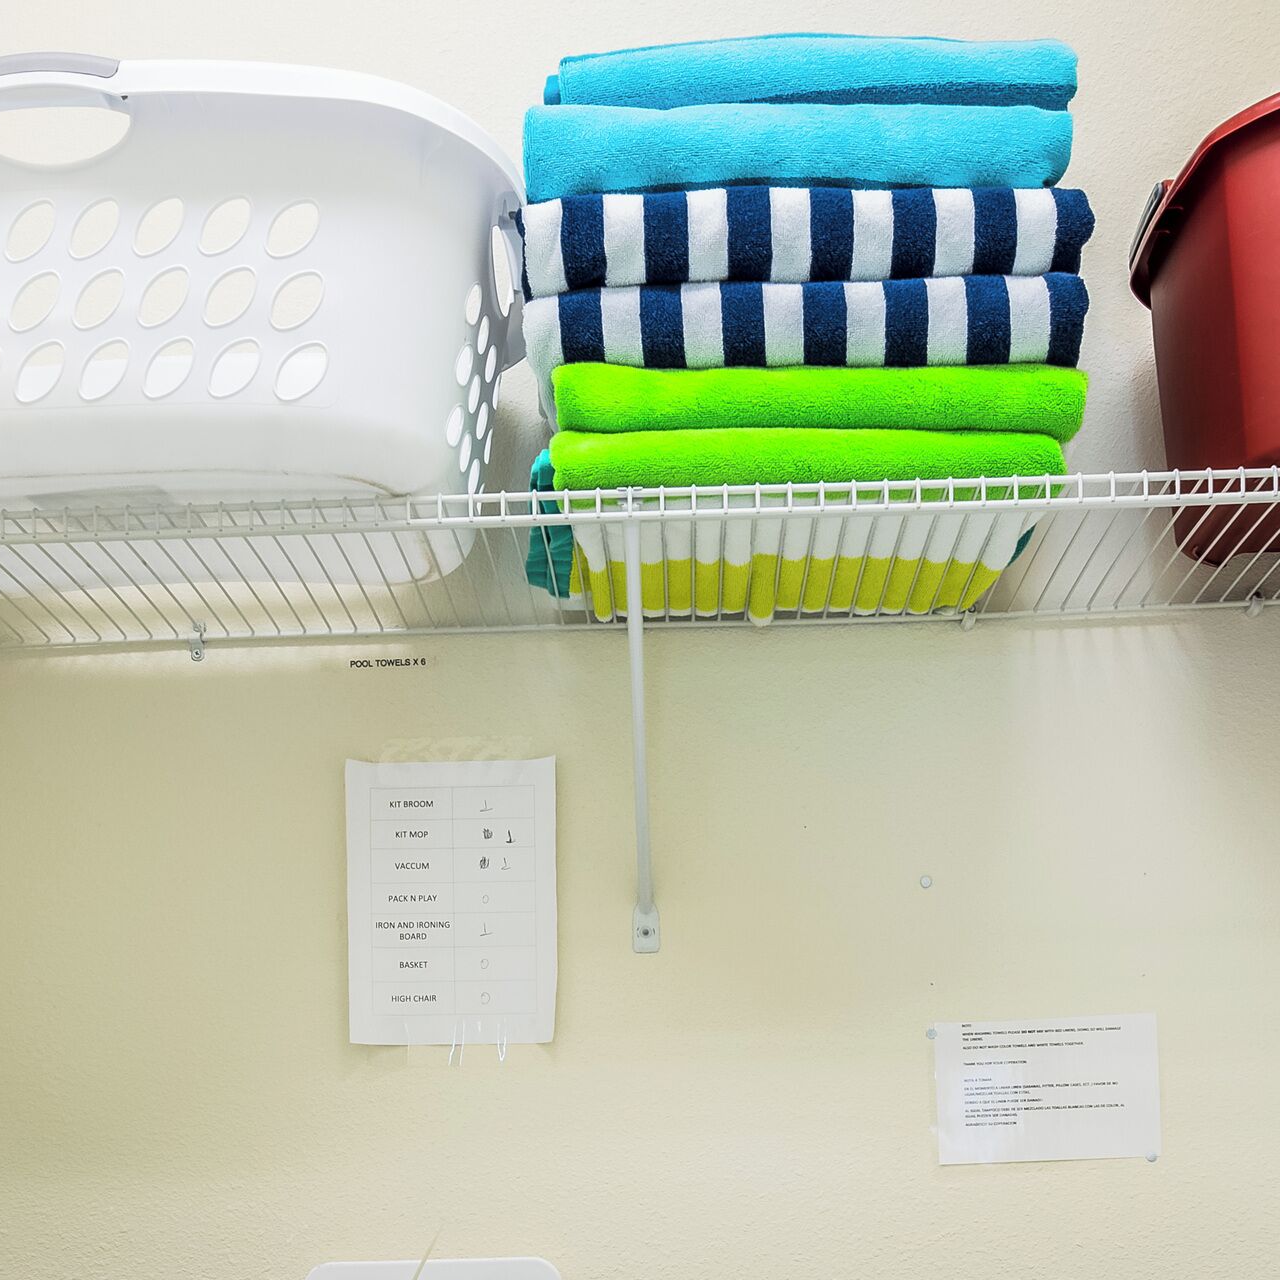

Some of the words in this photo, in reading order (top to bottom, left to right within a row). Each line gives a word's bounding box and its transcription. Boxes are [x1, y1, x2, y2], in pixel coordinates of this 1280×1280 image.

[350, 660, 373, 668] POOL
[376, 659, 410, 667] TOWELS
[390, 800, 402, 808] KIT
[404, 800, 434, 808] BROOM
[410, 830, 428, 838] MOP
[395, 862, 430, 870] VACCUM
[418, 894, 438, 902] PLAY
[397, 921, 414, 929] AND
[416, 920, 450, 929] IRONING
[399, 932, 427, 940] BOARD
[399, 961, 428, 969] BASKET
[413, 994, 436, 1002] CHAIR
